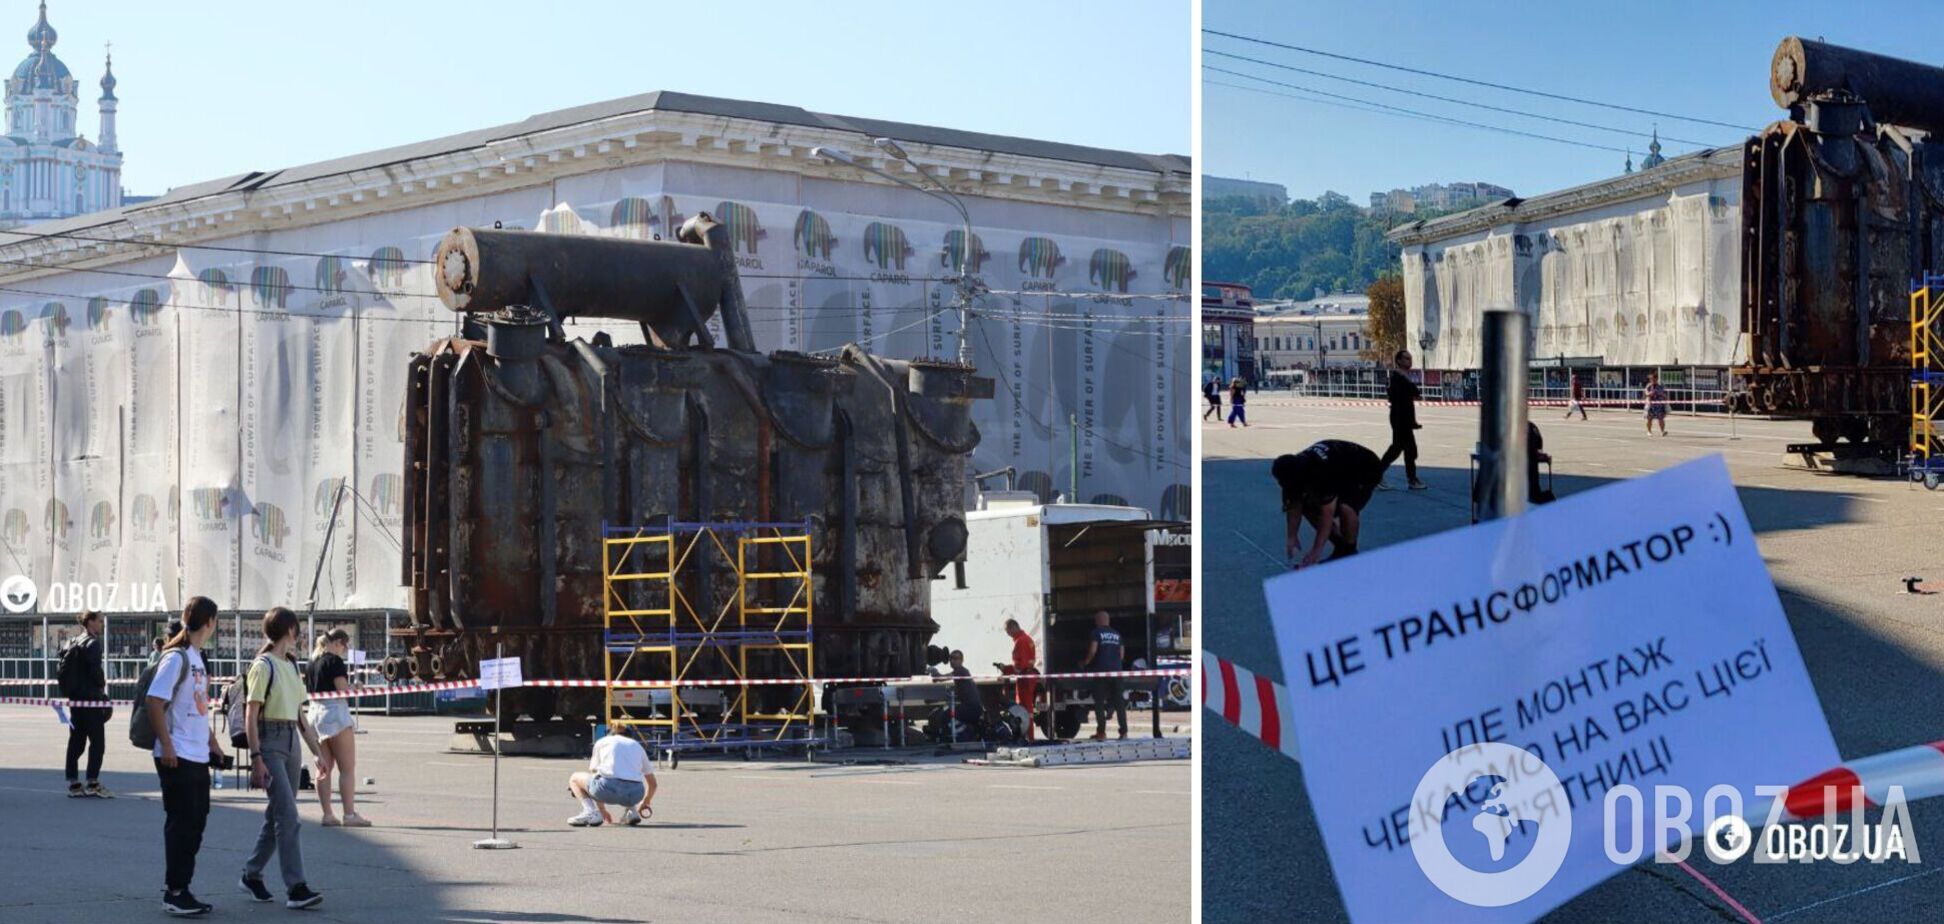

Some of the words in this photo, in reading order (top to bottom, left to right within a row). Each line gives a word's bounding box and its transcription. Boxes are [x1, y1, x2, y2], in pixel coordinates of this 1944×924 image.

[798, 259, 837, 277] CAPAROL
[870, 273, 910, 286] CAPAROL
[1014, 361, 1022, 377] OF
[314, 376, 321, 392] OF
[1084, 380, 1094, 394] OF
[1157, 375, 1165, 389] OF
[1013, 383, 1022, 429] POWER
[313, 397, 321, 439] POWER
[1084, 400, 1094, 447] POWER
[1157, 395, 1165, 441] POWER
[1013, 433, 1021, 457] THE
[1083, 455, 1093, 478] THE
[1157, 449, 1165, 472] THE
[254, 546, 286, 563] CAPAROL
[1306, 636, 1366, 688] ЦЕ
[1373, 523, 1695, 660] ТРАНСФОРМАТОР
[1442, 707, 1508, 764] ІДЕ
[1516, 636, 1674, 730] МОНТАЖ
[1362, 742, 1546, 852] ЧЕКАЄМО
[1553, 716, 1610, 762] НА
[1613, 680, 1690, 734] ВАС
[1696, 638, 1773, 698] ЦІЄЇ
